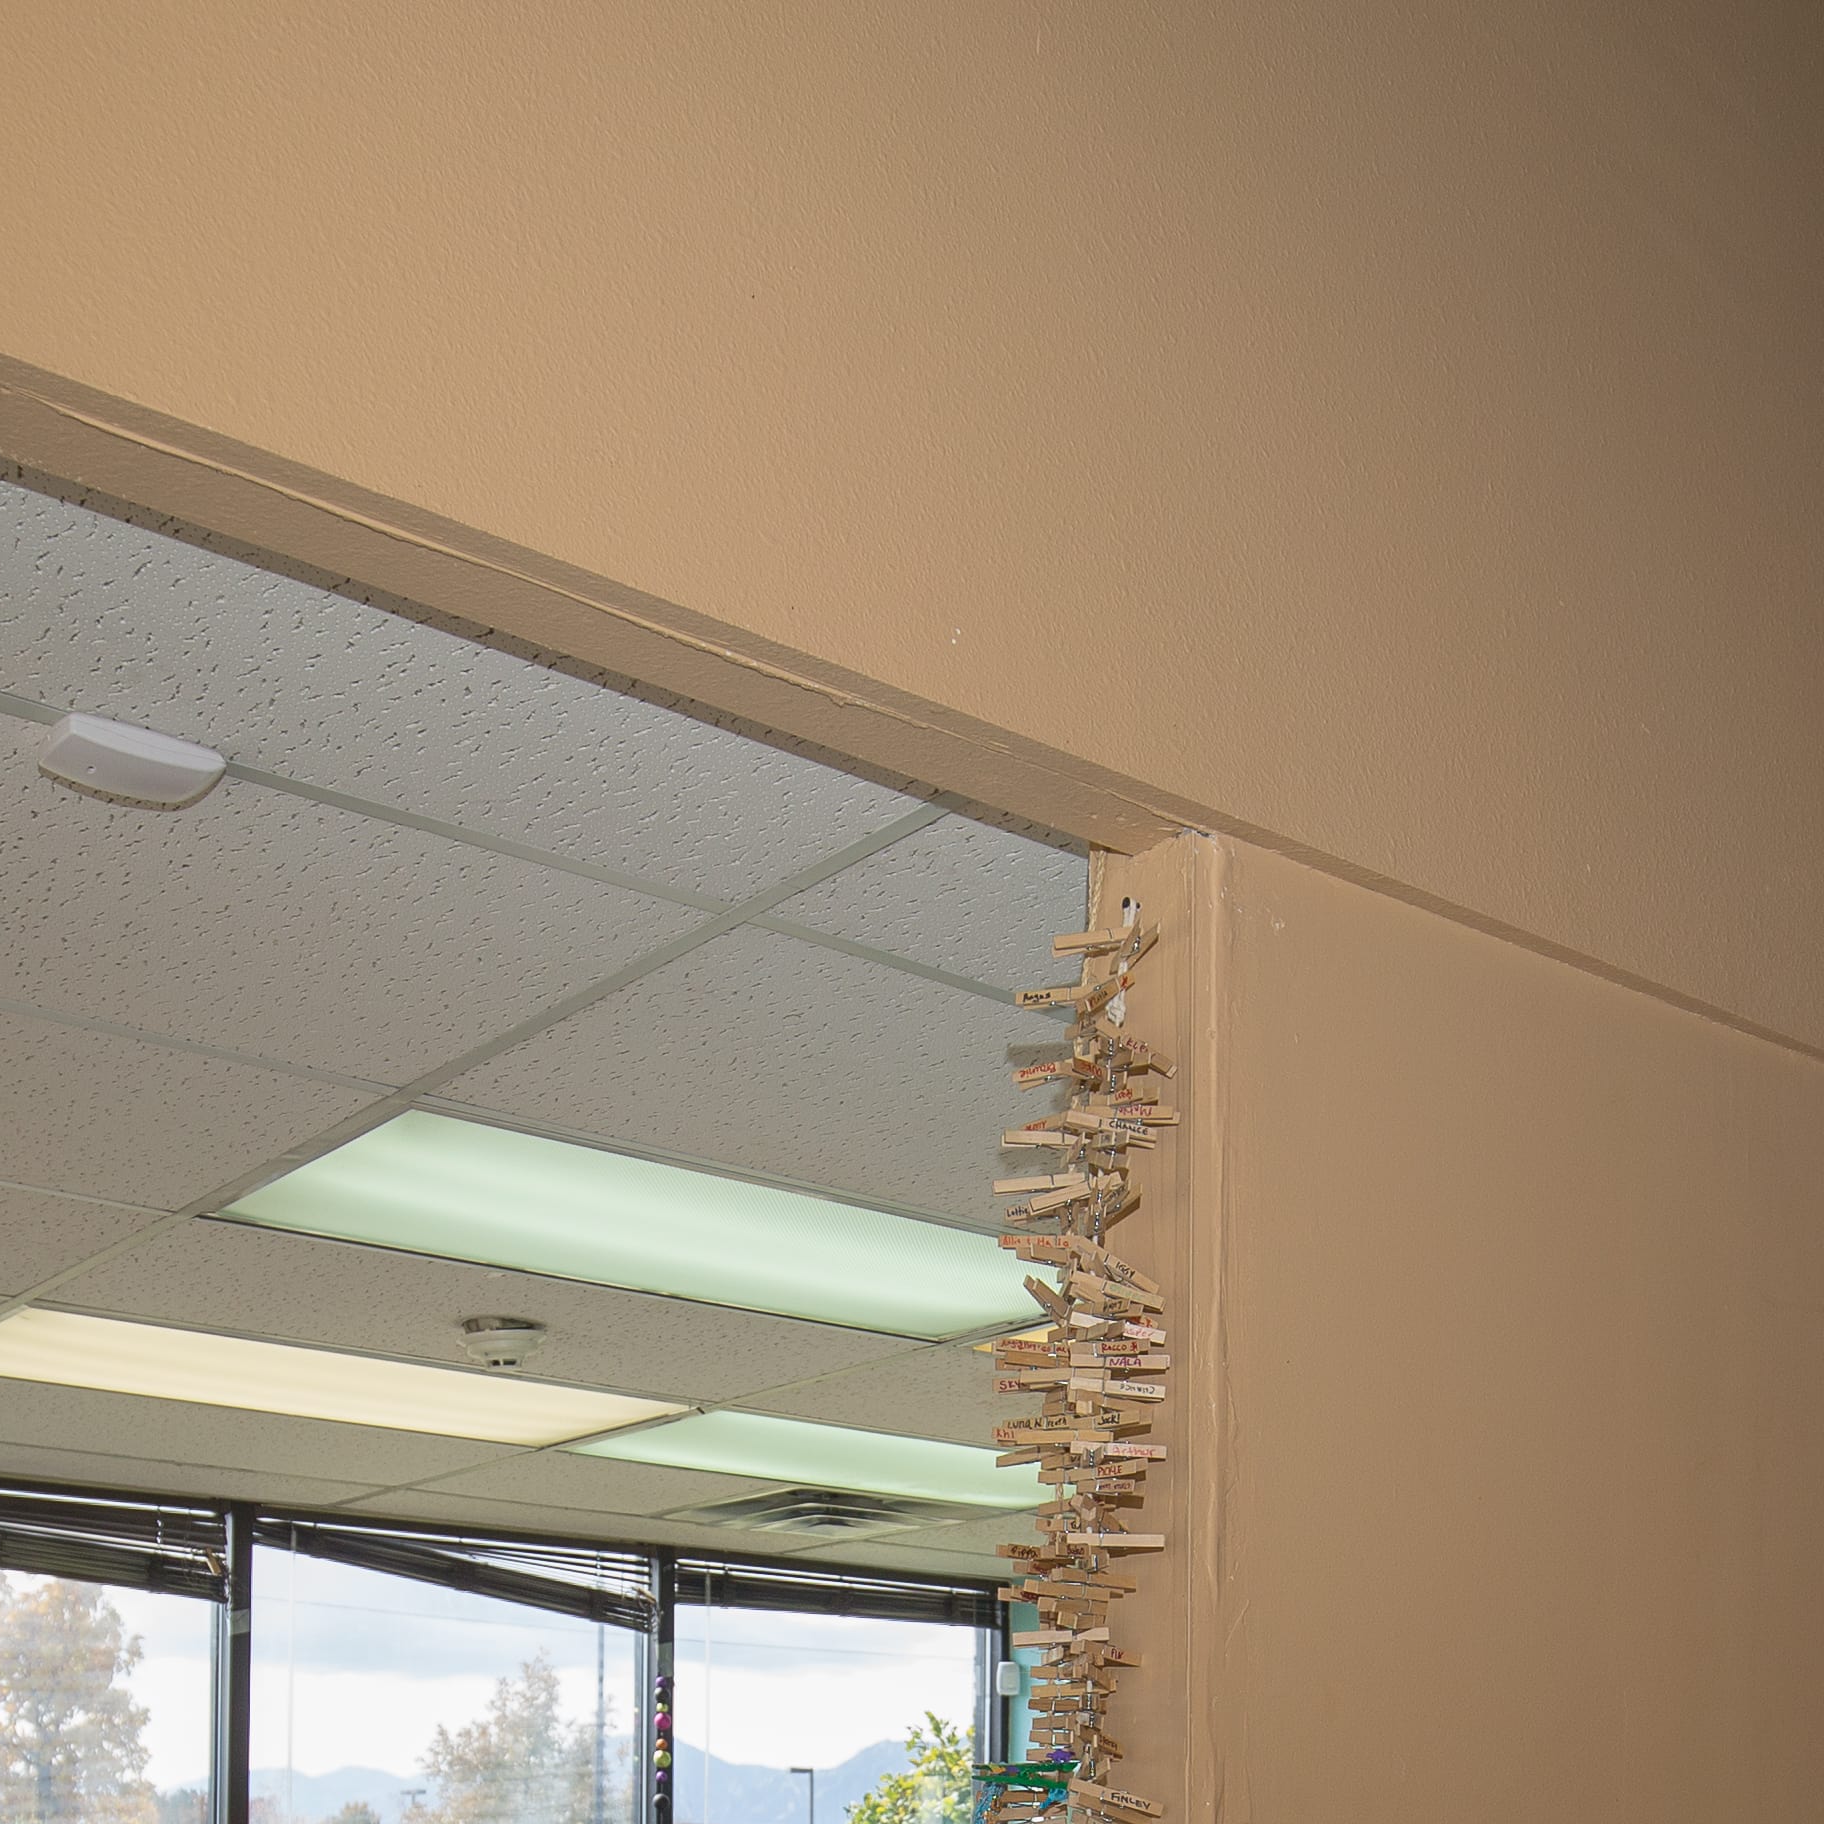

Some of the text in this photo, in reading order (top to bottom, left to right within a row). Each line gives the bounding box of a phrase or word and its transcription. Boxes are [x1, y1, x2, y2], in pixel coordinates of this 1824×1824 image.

[1108, 1117, 1150, 1136] CHANCE
[1115, 1261, 1136, 1278] IGGY
[1108, 1355, 1142, 1367] NALA
[1110, 1792, 1152, 1810] FINLEY
